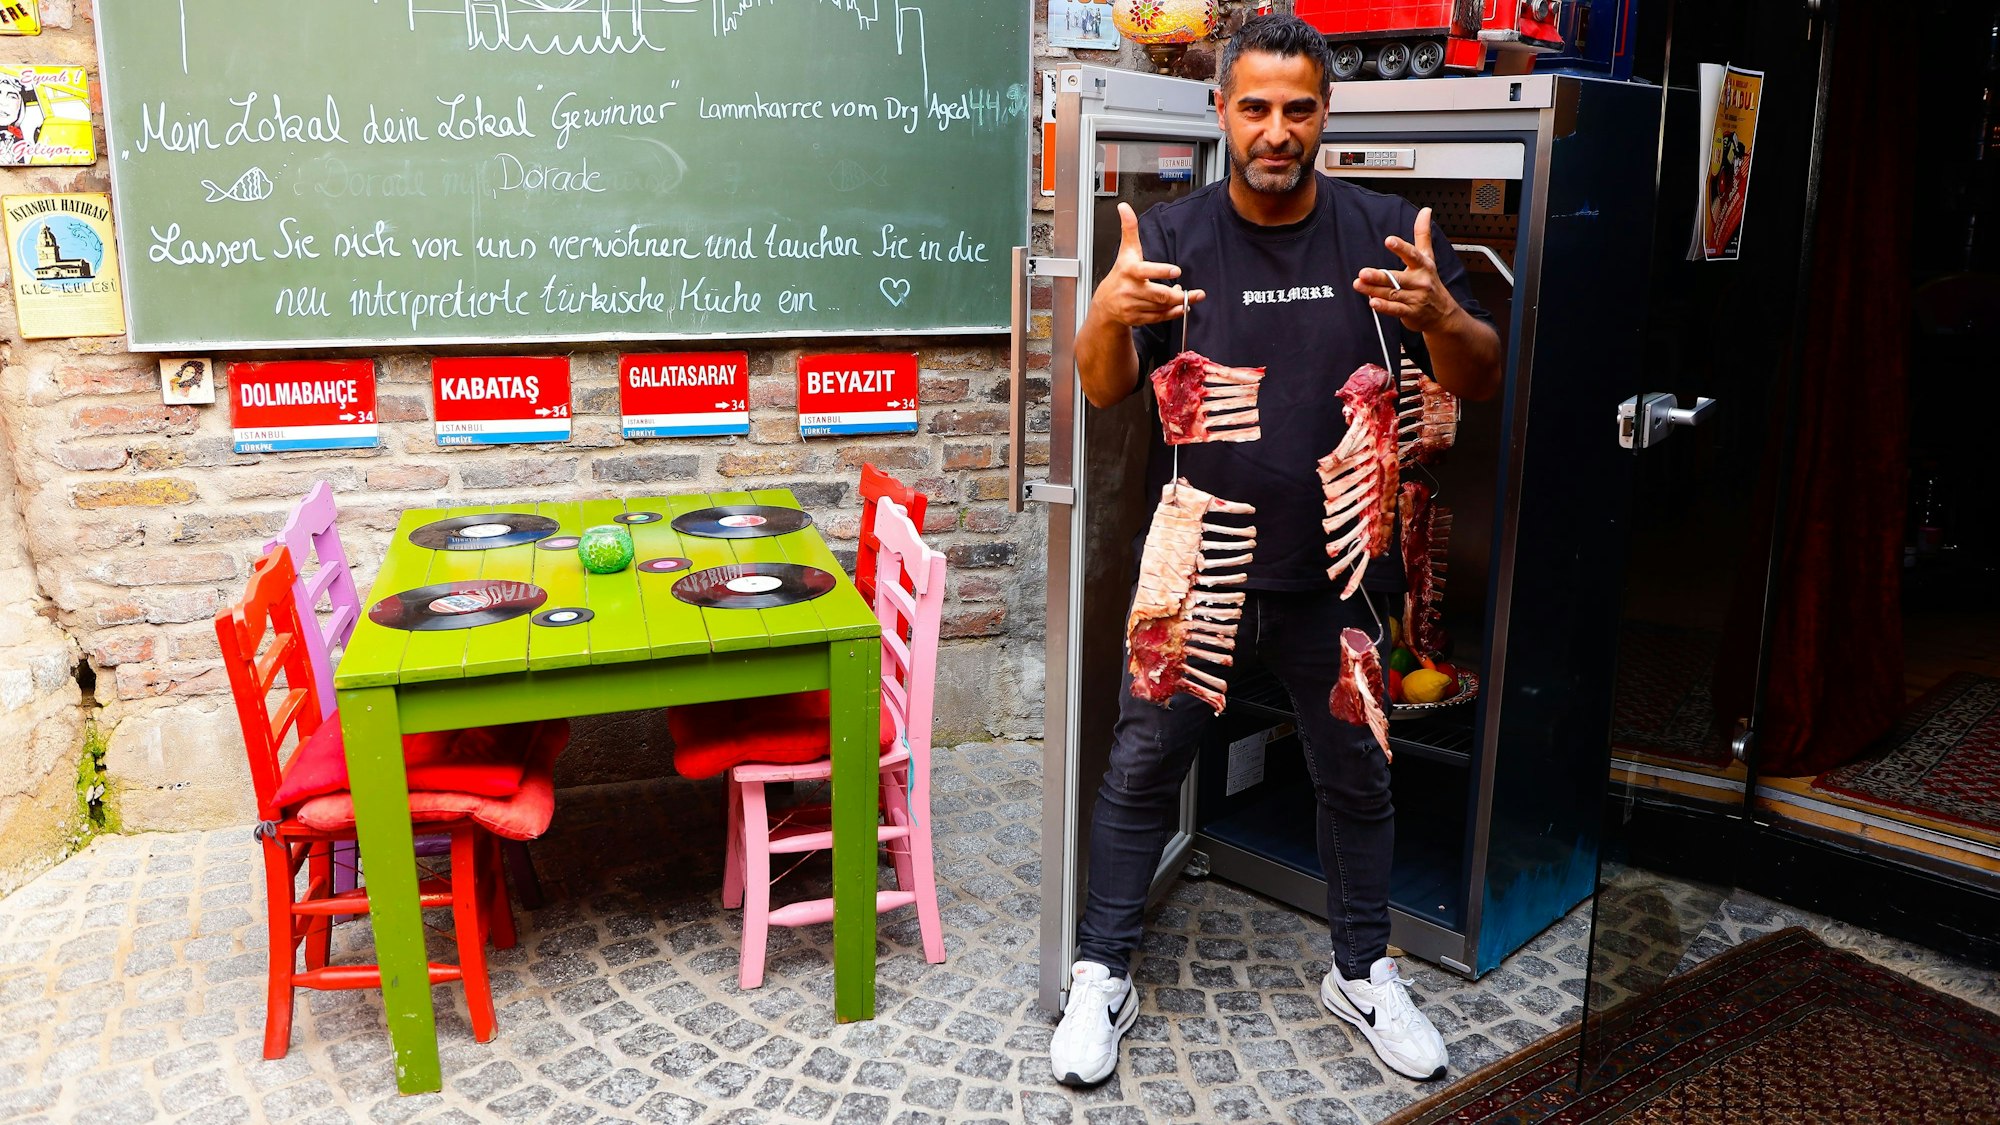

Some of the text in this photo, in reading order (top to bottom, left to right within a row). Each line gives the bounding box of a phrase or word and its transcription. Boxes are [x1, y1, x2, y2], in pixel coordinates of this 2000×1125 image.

[20, 69, 68, 84] Eyvah
[225, 91, 349, 146] Lokal
[363, 103, 429, 145] dein
[831, 102, 878, 121] vom
[884, 97, 919, 134] Dry
[927, 92, 971, 132] Aged
[9, 198, 109, 222] İSTANBUL HATIRASI
[149, 217, 989, 268] Lassen Sie sich von uns verwöhnen und tauchen Sie in die
[275, 285, 332, 317] neu
[350, 278, 529, 331] interpretierte
[540, 274, 665, 314] türkische
[680, 276, 762, 314] Küche
[778, 283, 817, 314] ein
[1242, 284, 1335, 306] PULLMARK
[629, 364, 737, 388] GALATASARAY
[807, 369, 896, 395] BEYAZIT
[240, 379, 358, 410] DOLMABAHÇE
[440, 375, 541, 405] KABATAŞ
[552, 404, 568, 418] 34
[731, 399, 746, 411] 34
[902, 398, 915, 410] 34
[357, 410, 374, 423] 34
[442, 435, 473, 444] TÜRKİYE
[627, 428, 657, 438] TÜRKİYE
[804, 427, 832, 435] TÜRKİYE
[240, 442, 273, 452] TÜRKİYE
